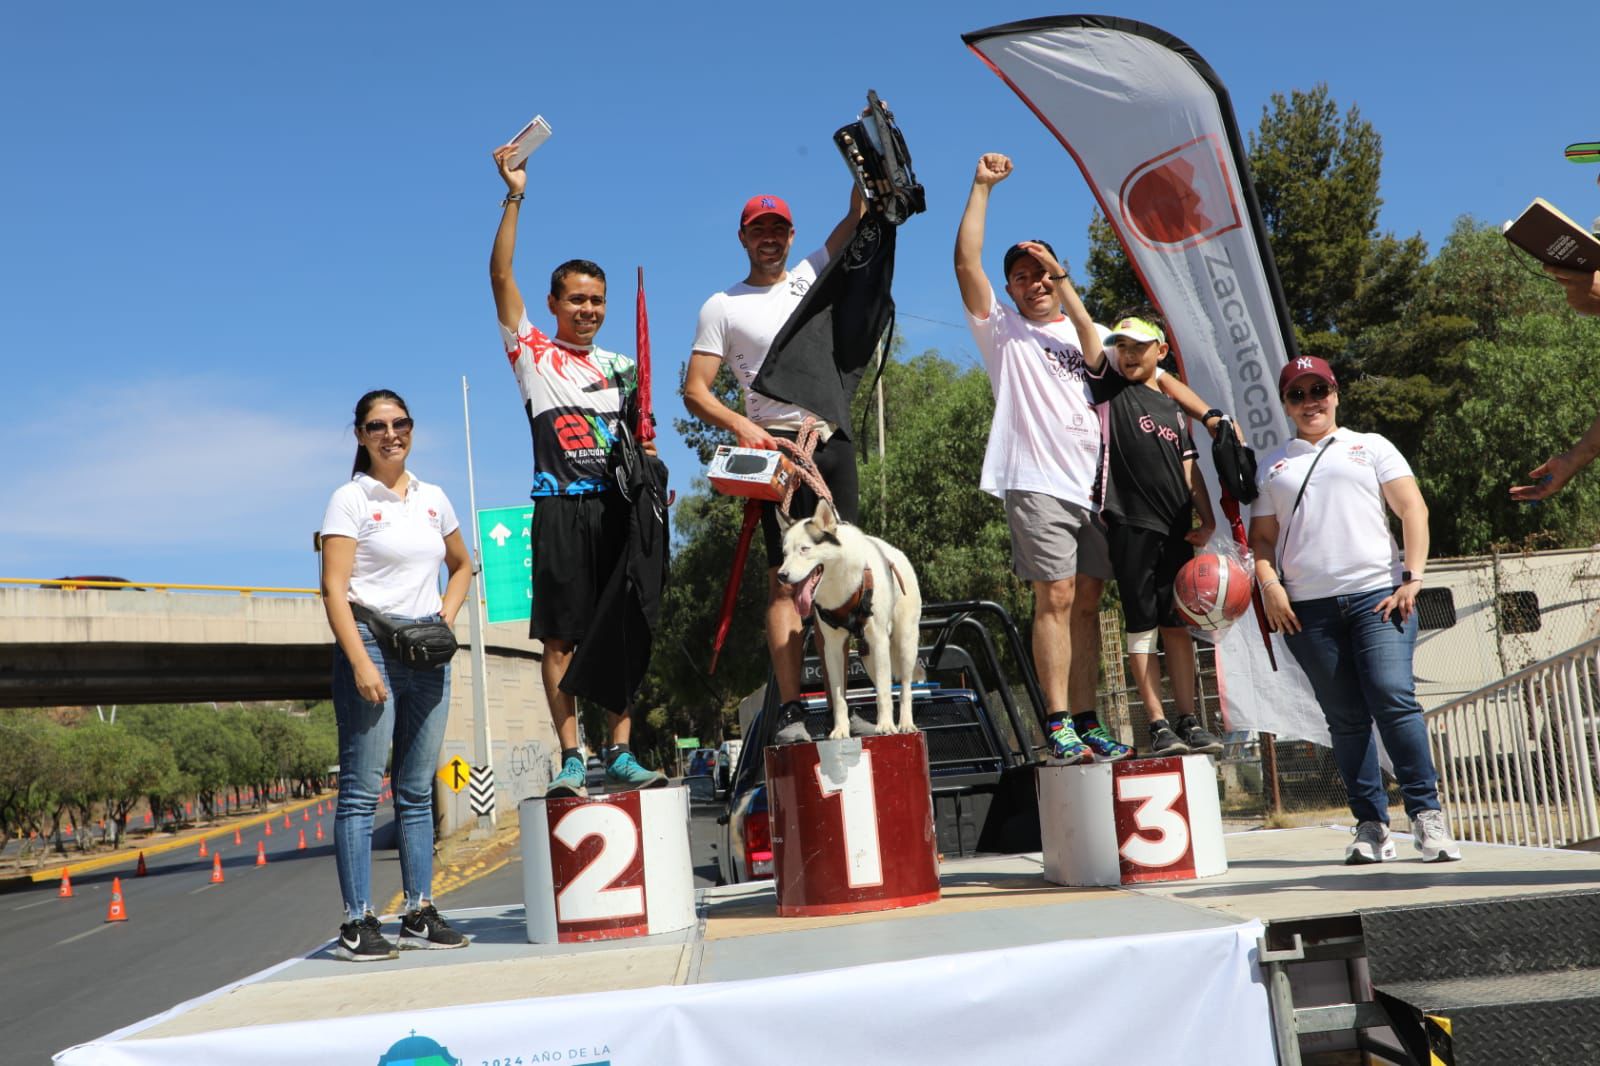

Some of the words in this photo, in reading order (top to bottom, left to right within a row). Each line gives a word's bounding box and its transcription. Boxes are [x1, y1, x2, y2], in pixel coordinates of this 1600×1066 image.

[1205, 246, 1278, 450] Zacatecas
[552, 803, 645, 923] 2
[815, 749, 884, 889] 1
[1116, 771, 1190, 868] 3
[531, 1050, 562, 1064] AÑO
[568, 1047, 587, 1059] DE
[593, 1044, 611, 1057] LA
